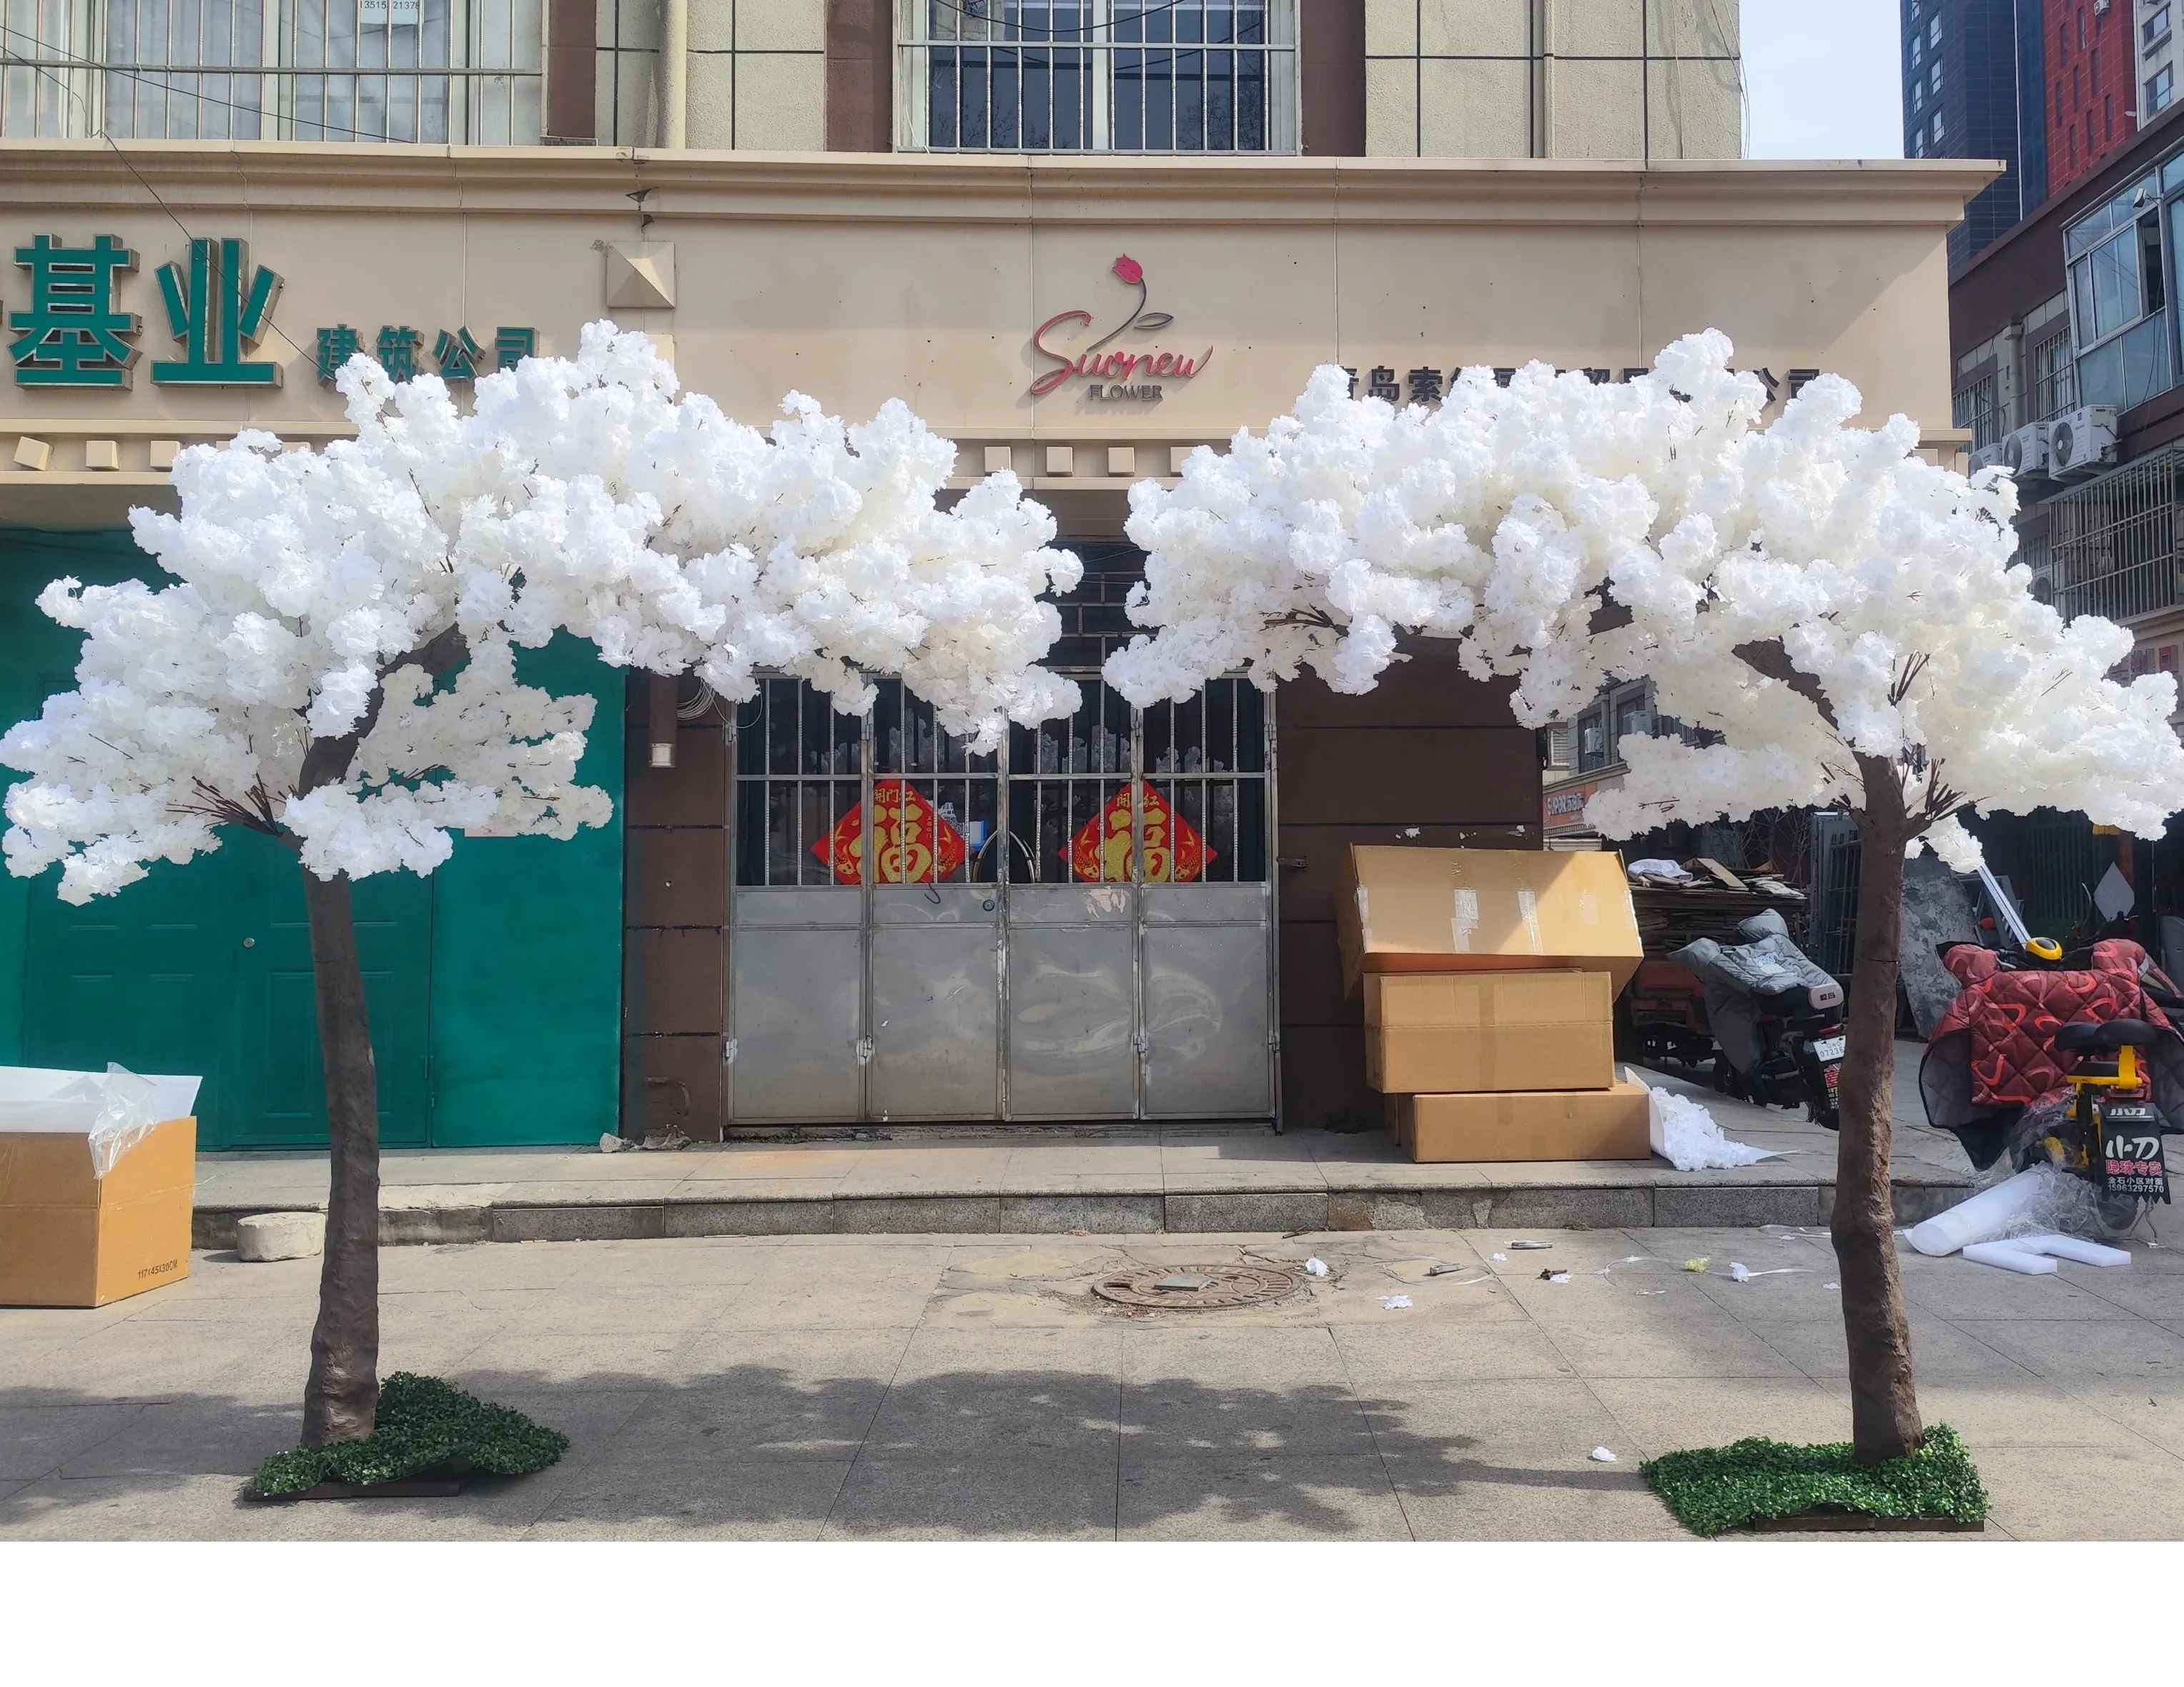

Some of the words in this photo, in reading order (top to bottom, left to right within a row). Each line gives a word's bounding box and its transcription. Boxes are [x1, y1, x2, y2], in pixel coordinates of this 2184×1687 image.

[360, 1, 420, 9] 1351521378
[316, 324, 541, 385] 建筑公司
[1089, 384, 1164, 401] FLOWER
[848, 803, 932, 884] 福
[1094, 808, 1172, 883] 福
[2105, 1134, 2160, 1160] 小刀
[2105, 1159, 2163, 1177] 隐珠专卖
[2108, 1176, 2163, 1185] 金石小区对面
[2108, 1184, 2165, 1193] 15963297570
